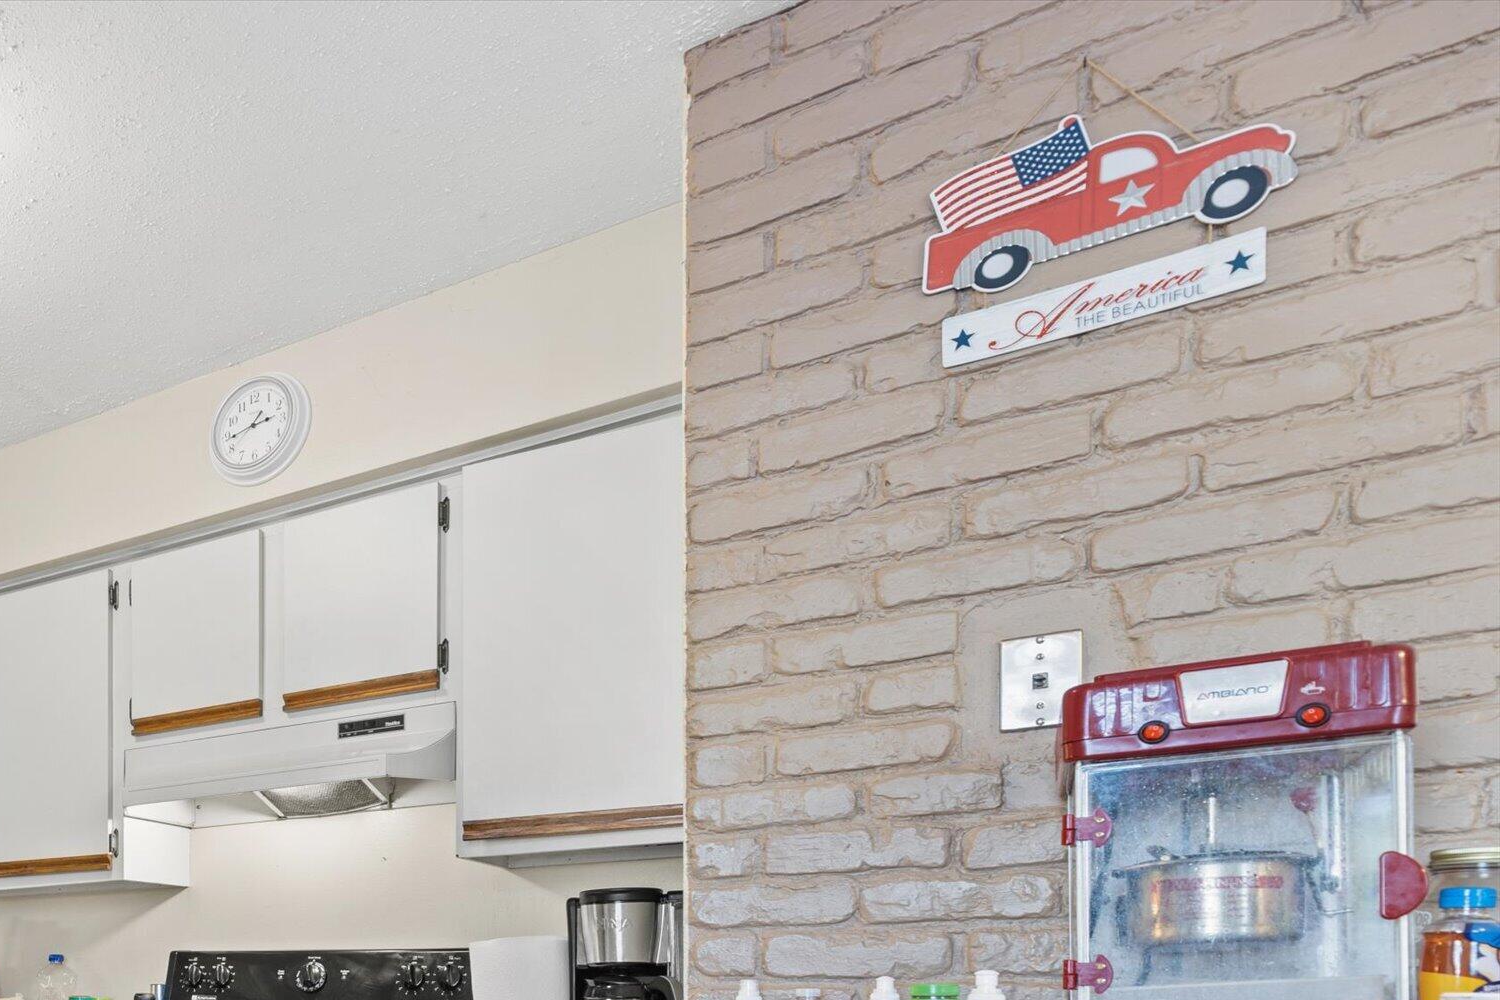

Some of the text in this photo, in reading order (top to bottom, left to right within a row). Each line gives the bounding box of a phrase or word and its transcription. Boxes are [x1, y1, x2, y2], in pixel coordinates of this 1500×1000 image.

[988, 263, 1205, 351] America
[1075, 284, 1205, 329] THE BEAUTIFUL
